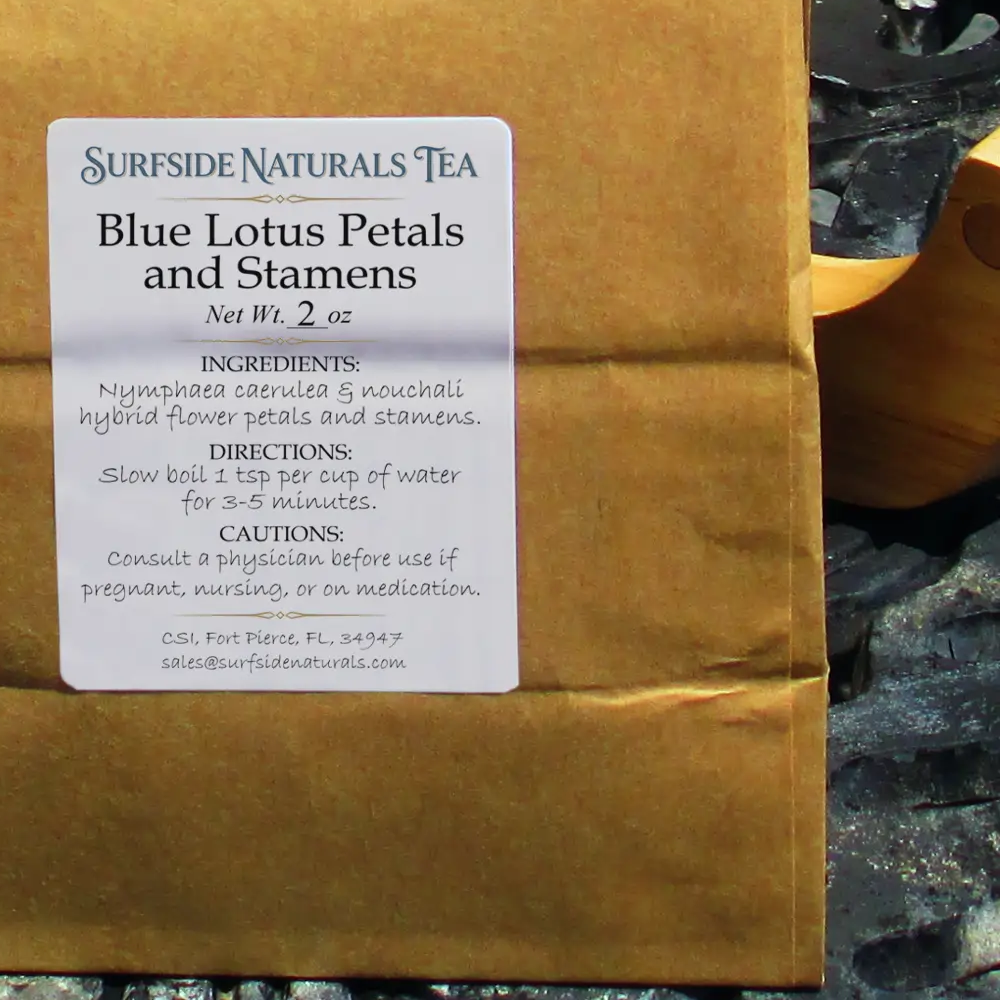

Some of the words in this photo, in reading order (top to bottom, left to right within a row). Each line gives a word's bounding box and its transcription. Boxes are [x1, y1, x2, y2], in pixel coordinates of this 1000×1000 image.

[96, 212, 191, 247] Blue
[205, 213, 324, 247] Lotus
[338, 212, 464, 247] Petals
[144, 255, 224, 289] and
[237, 256, 416, 289] Stamens
[205, 305, 244, 324] Net
[253, 305, 284, 323] Wt.
[295, 300, 317, 328] 2
[328, 311, 352, 324] oz
[201, 354, 363, 372] INGREDIENTS:
[100, 380, 224, 410] Nymphaea
[235, 380, 327, 399] caerulea
[337, 382, 352, 404] &
[362, 380, 464, 398] nouchali
[80, 406, 158, 435] hybrid
[164, 405, 238, 429] flower
[244, 407, 311, 432] petals
[321, 407, 365, 425] and
[375, 408, 480, 426] stamens.
[209, 444, 352, 460] DIRECTIONS:
[99, 465, 158, 483] Slow
[167, 464, 207, 483] boil
[216, 469, 228, 483] 1
[236, 467, 270, 491] tsp
[278, 469, 312, 492] per
[320, 470, 359, 491] cup
[368, 463, 392, 490] of
[397, 467, 461, 484] water
[181, 493, 215, 516] for
[222, 494, 265, 509] 3-5
[273, 492, 376, 510] minutes.
[220, 526, 343, 542] CAUTIONS:
[108, 550, 191, 566] Consult
[199, 553, 208, 565] a
[216, 549, 324, 575] physician
[332, 548, 390, 571] before
[399, 554, 432, 566] use
[440, 548, 459, 571] if
[81, 581, 185, 602] pregnant,
[195, 579, 288, 602] nursing,
[297, 584, 316, 596] or
[324, 584, 349, 596] on
[357, 579, 479, 596] medication.
[162, 632, 198, 645] CSI,
[206, 632, 240, 644] Fort
[246, 630, 299, 645] Pierce,
[307, 633, 333, 646] FL,
[340, 632, 402, 649] 34947
[162, 653, 406, 672] sales@surfsidenaturals.com
